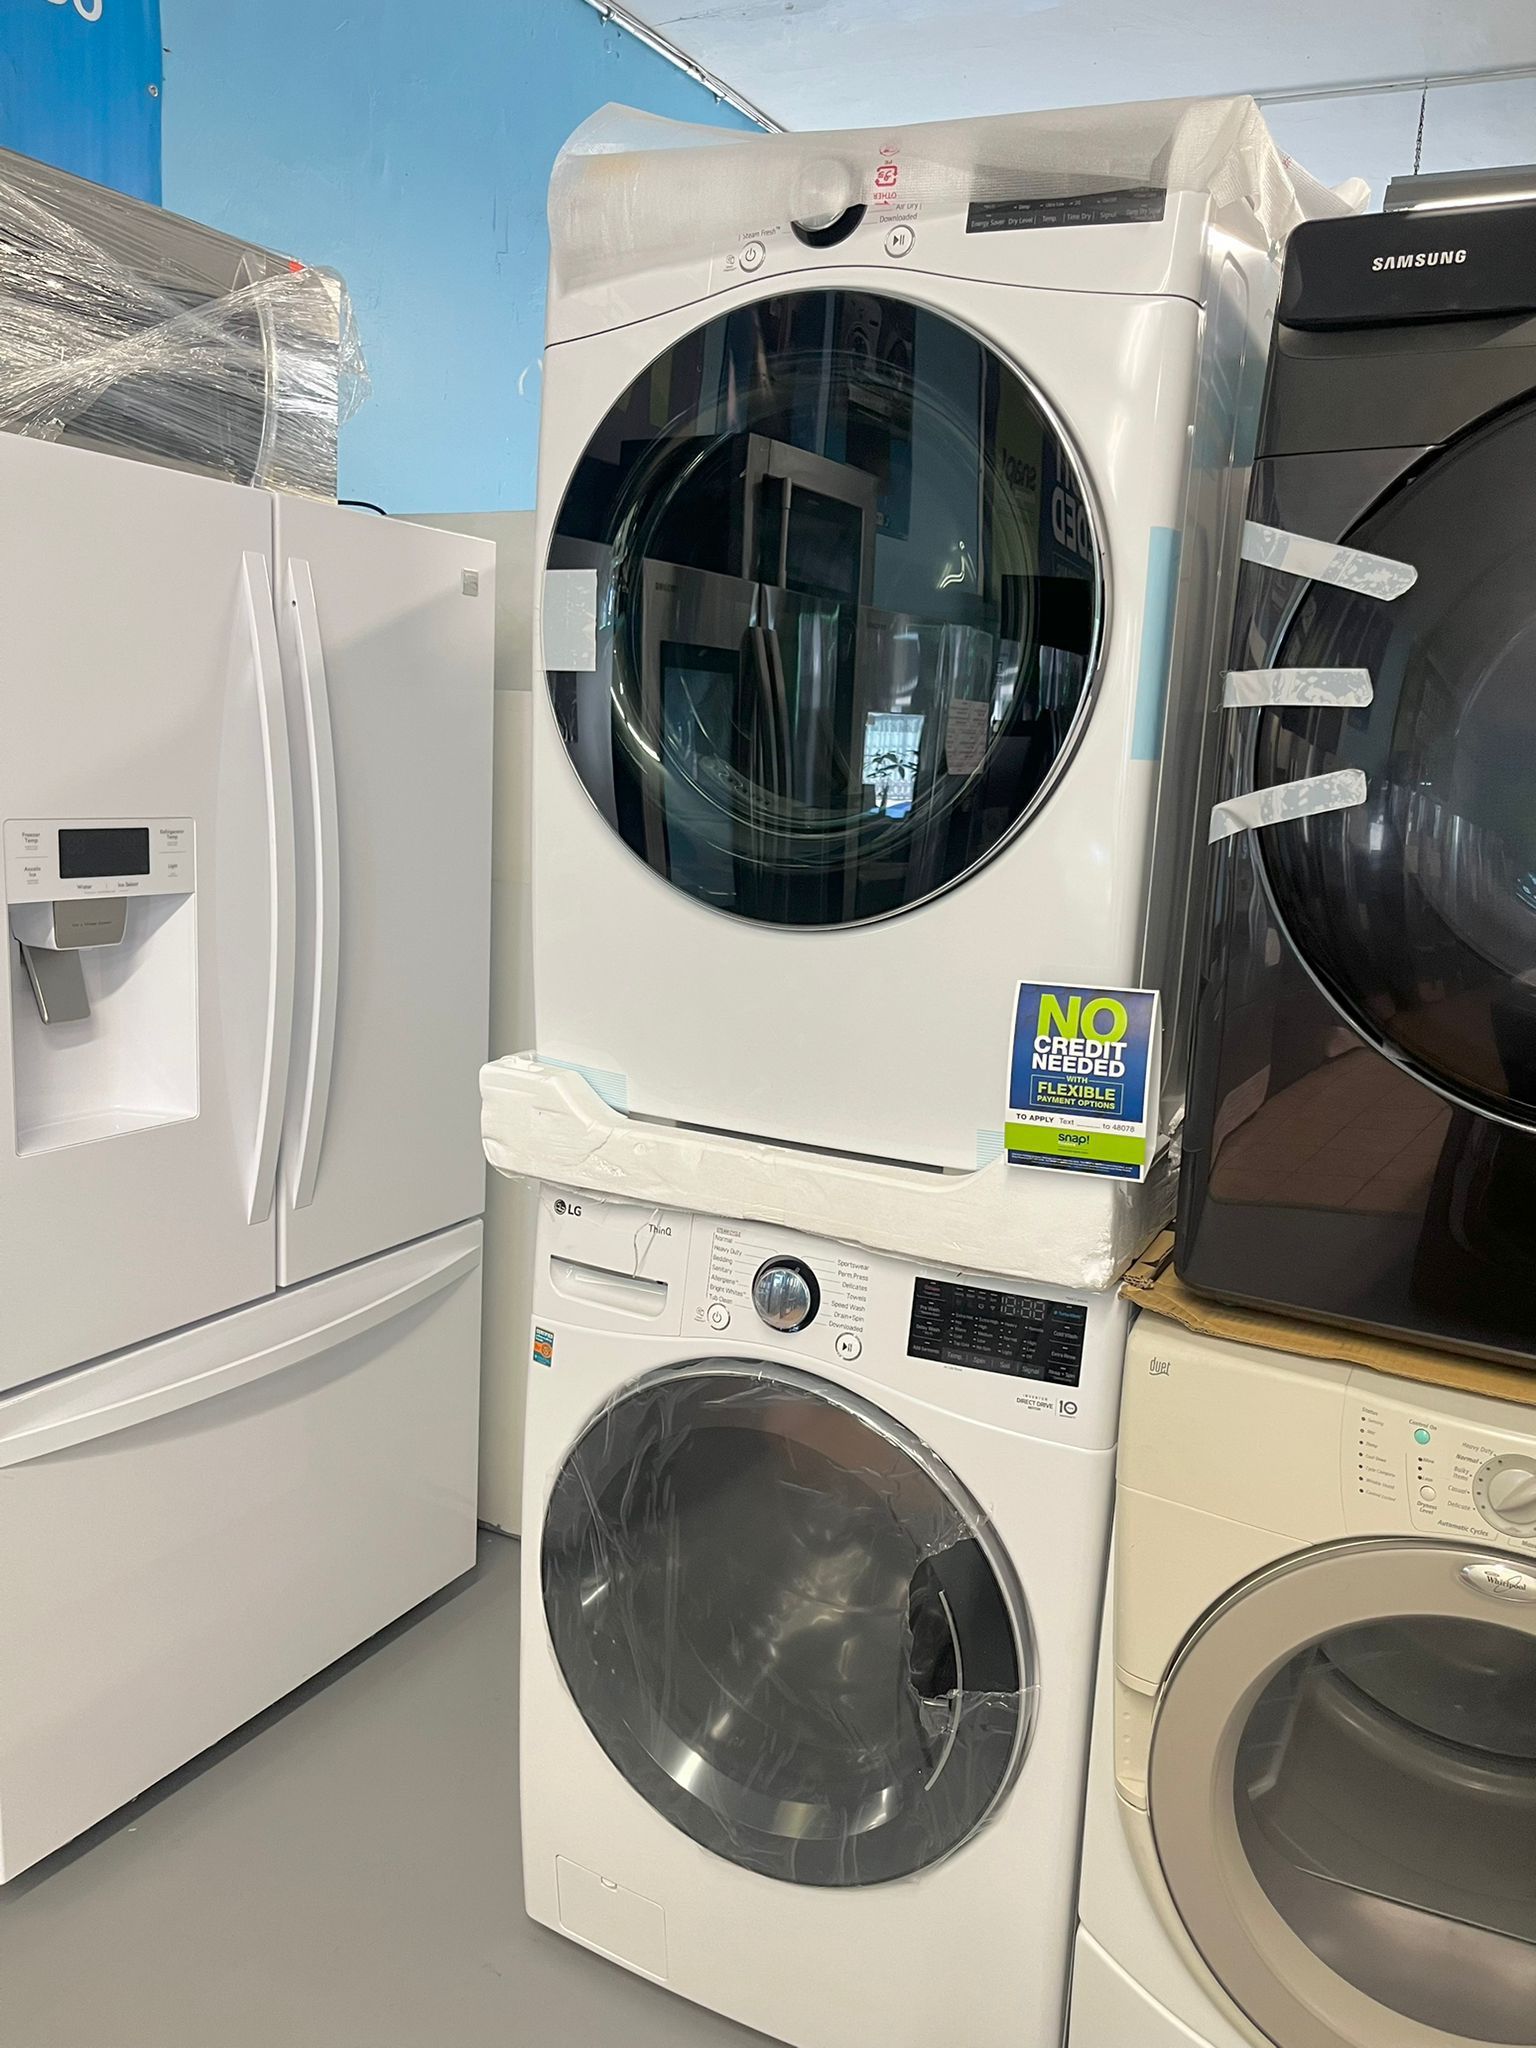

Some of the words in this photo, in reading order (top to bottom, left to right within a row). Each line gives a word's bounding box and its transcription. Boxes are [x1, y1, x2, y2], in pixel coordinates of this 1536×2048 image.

[873, 192, 897, 200] OTHER
[879, 212, 918, 223] Downloaded
[1008, 217, 1018, 226] Dry
[1019, 216, 1033, 225] Level
[742, 230, 760, 240] Steam
[1371, 249, 1477, 271] SAMSUNG
[1036, 993, 1128, 1043] NO
[1033, 1035, 1128, 1061] CREDIT
[1031, 1053, 1125, 1078] NEEDED
[1066, 1075, 1088, 1084] WITH
[1037, 1082, 1115, 1101] FLEXIBLE
[1036, 1095, 1076, 1106] PAYMENT
[1078, 1098, 1115, 1110] OPTIONS
[1029, 1114, 1054, 1124] APPLY
[1059, 1117, 1075, 1126] Text
[1111, 1123, 1135, 1133] 48078
[1058, 1133, 1090, 1146] snap!
[568, 1204, 582, 1217] LG
[648, 1224, 672, 1237] ThinQ
[714, 1234, 733, 1244] Normal
[713, 1245, 729, 1254] Heavy
[730, 1247, 743, 1257] Duty
[712, 1254, 733, 1265] Bedding
[837, 1259, 870, 1271] Sportswear
[711, 1264, 733, 1275] Sanitary
[709, 1284, 725, 1293] Bright
[841, 1281, 868, 1292] Delicates
[709, 1293, 718, 1302] Tub
[846, 1292, 867, 1302] Towels
[831, 1300, 849, 1311] Speed
[849, 1303, 866, 1312] Wash
[828, 1320, 864, 1333] Downloaded
[1022, 1366, 1040, 1375] Signal
[1149, 1356, 1171, 1375] duet
[1016, 1397, 1036, 1407] DIRECT
[1036, 1400, 1054, 1410] DRIVE
[1059, 1400, 1078, 1415] 10
[1362, 1406, 1379, 1416] Status
[1408, 1418, 1429, 1429] Control
[1429, 1423, 1438, 1431] On
[1462, 1441, 1480, 1453] Heavy
[1480, 1446, 1494, 1456] Duty
[1455, 1453, 1480, 1465] Normal
[1454, 1465, 1470, 1477] Bulky
[1452, 1473, 1469, 1482] Items
[1448, 1484, 1466, 1495] Casual
[1416, 1501, 1438, 1512] Dryness
[1419, 1507, 1434, 1516] Level
[1447, 1500, 1471, 1511] Delicate
[1437, 1518, 1470, 1534] Automatic
[1470, 1526, 1489, 1538] Cycles
[1486, 1575, 1527, 1591] Whirlpool
